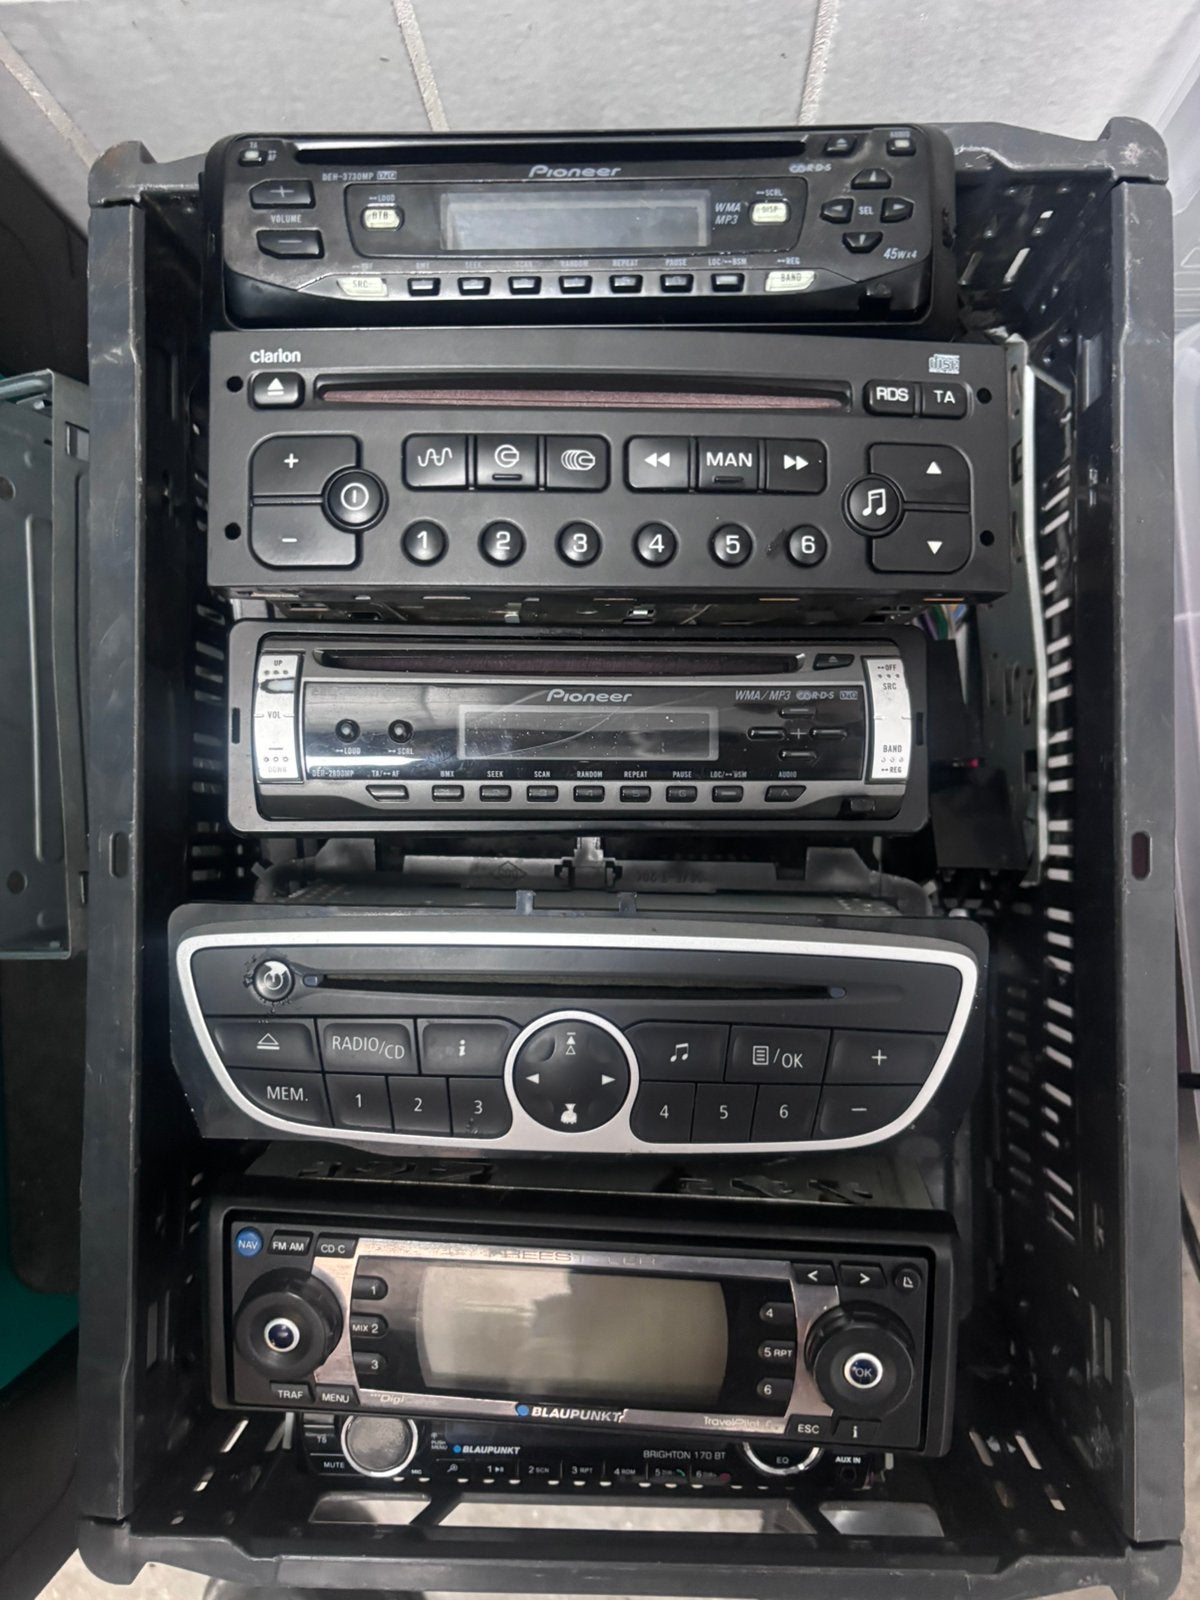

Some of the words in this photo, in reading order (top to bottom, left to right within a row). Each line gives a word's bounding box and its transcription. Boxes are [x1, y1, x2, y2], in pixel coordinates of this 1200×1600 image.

[528, 164, 621, 178] Pioneer
[714, 202, 741, 213] WMA
[858, 206, 874, 216] SEL
[270, 214, 302, 224] VOLUME
[714, 214, 739, 225] MP3
[876, 387, 909, 402] RDS
[933, 390, 956, 404] TA
[706, 452, 752, 467] MAN
[417, 531, 428, 549] 1
[495, 531, 510, 550] 2
[573, 533, 588, 552] 3
[648, 533, 664, 553] 4
[725, 535, 740, 554] 5
[801, 535, 816, 554] 6
[273, 659, 283, 667] UP
[885, 664, 897, 672] OFF
[882, 682, 897, 690] SRC
[546, 688, 632, 703] Pioneer
[267, 711, 281, 719] VOL
[882, 744, 903, 753] BAND
[486, 770, 504, 778] SEEK
[534, 770, 551, 778] SCAN
[576, 770, 603, 778] RANDOM
[623, 770, 648, 778] REPEAT
[672, 770, 692, 778] PAUSE
[778, 771, 797, 779] AUDIO
[889, 766, 902, 774] REG
[331, 1035, 406, 1060] RADIO/CD
[266, 1085, 308, 1102] MEM.
[355, 1093, 362, 1108] 1
[413, 1098, 423, 1112] 2
[473, 1100, 483, 1115] 3
[659, 1104, 670, 1119] 4
[719, 1104, 729, 1119] 5
[779, 1104, 789, 1119] 6
[237, 1239, 259, 1250] NAV
[320, 1243, 335, 1254] CD
[370, 1286, 377, 1295] 1
[765, 1308, 774, 1318] 4
[352, 1324, 368, 1333] MIX
[371, 1323, 379, 1334] 2
[764, 1347, 772, 1358] 5
[773, 1349, 793, 1358] RPT
[371, 1359, 379, 1370] 3
[855, 1367, 872, 1378] OK
[278, 1389, 303, 1399] TRAF
[763, 1384, 772, 1395] 6
[321, 1392, 350, 1403] MENU
[531, 1406, 621, 1423] BLAUPUNKT
[797, 1424, 820, 1435] ESC
[462, 1445, 520, 1455] BLAUPUNKT
[642, 1449, 691, 1460] BRIGHTON
[694, 1450, 712, 1461] 170
[714, 1451, 726, 1461] BT
[323, 1461, 345, 1469] MUTE
[776, 1456, 790, 1464] EQ
[835, 1456, 852, 1464] AUX
[852, 1456, 861, 1464] IN
[528, 1466, 535, 1474] 2
[571, 1466, 578, 1474] 3
[613, 1467, 620, 1475] 4
